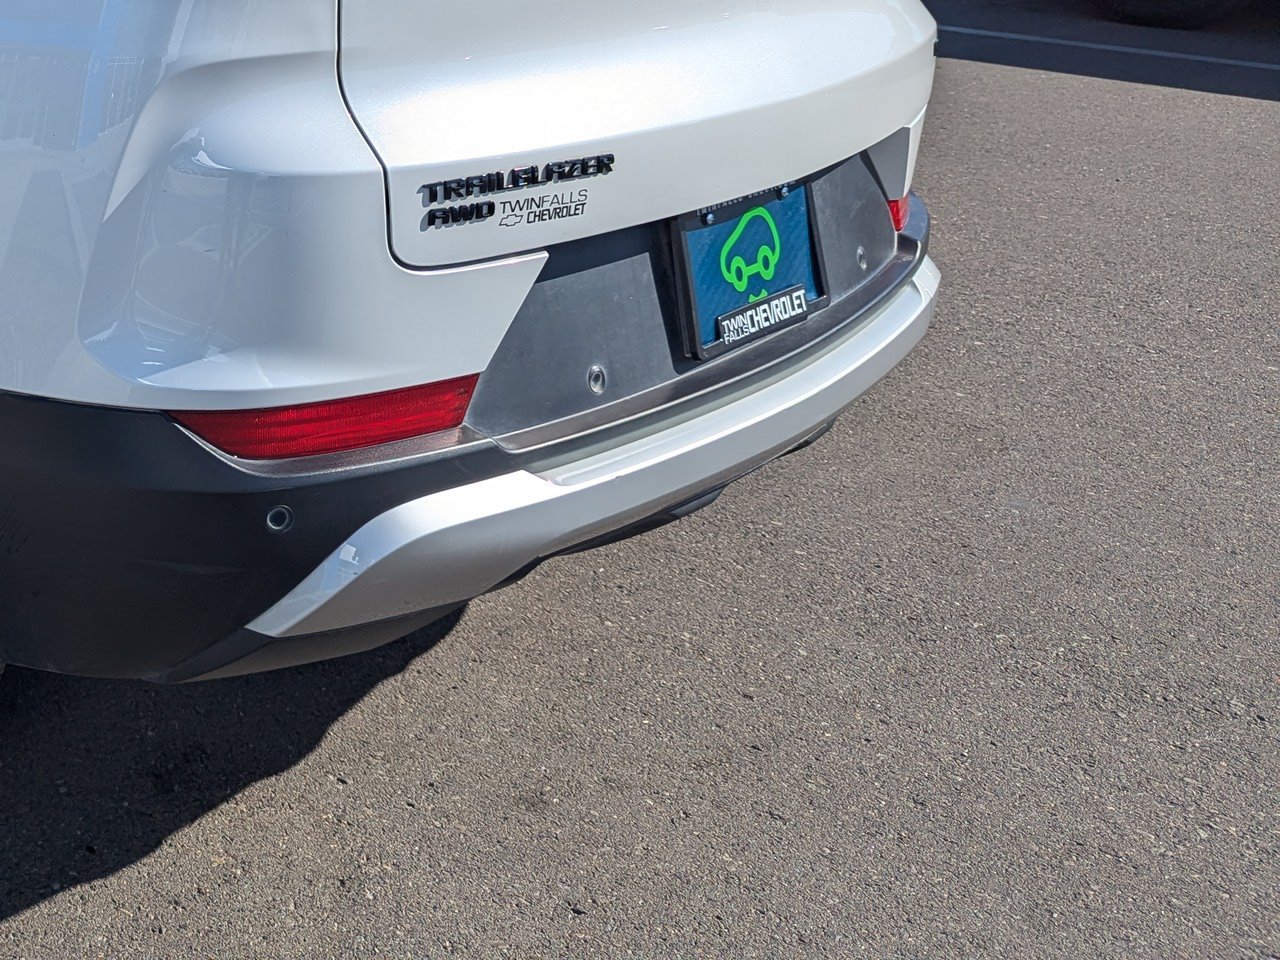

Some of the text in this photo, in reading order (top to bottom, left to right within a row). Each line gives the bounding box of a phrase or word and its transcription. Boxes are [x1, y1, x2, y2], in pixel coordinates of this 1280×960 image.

[418, 153, 615, 204] TRAILBLAZER
[426, 199, 496, 227] AWD
[526, 202, 587, 224] CHEVROLET
[721, 312, 748, 335] TWIN
[746, 289, 808, 333] CHEVROLET
[723, 324, 751, 345] FALLS
